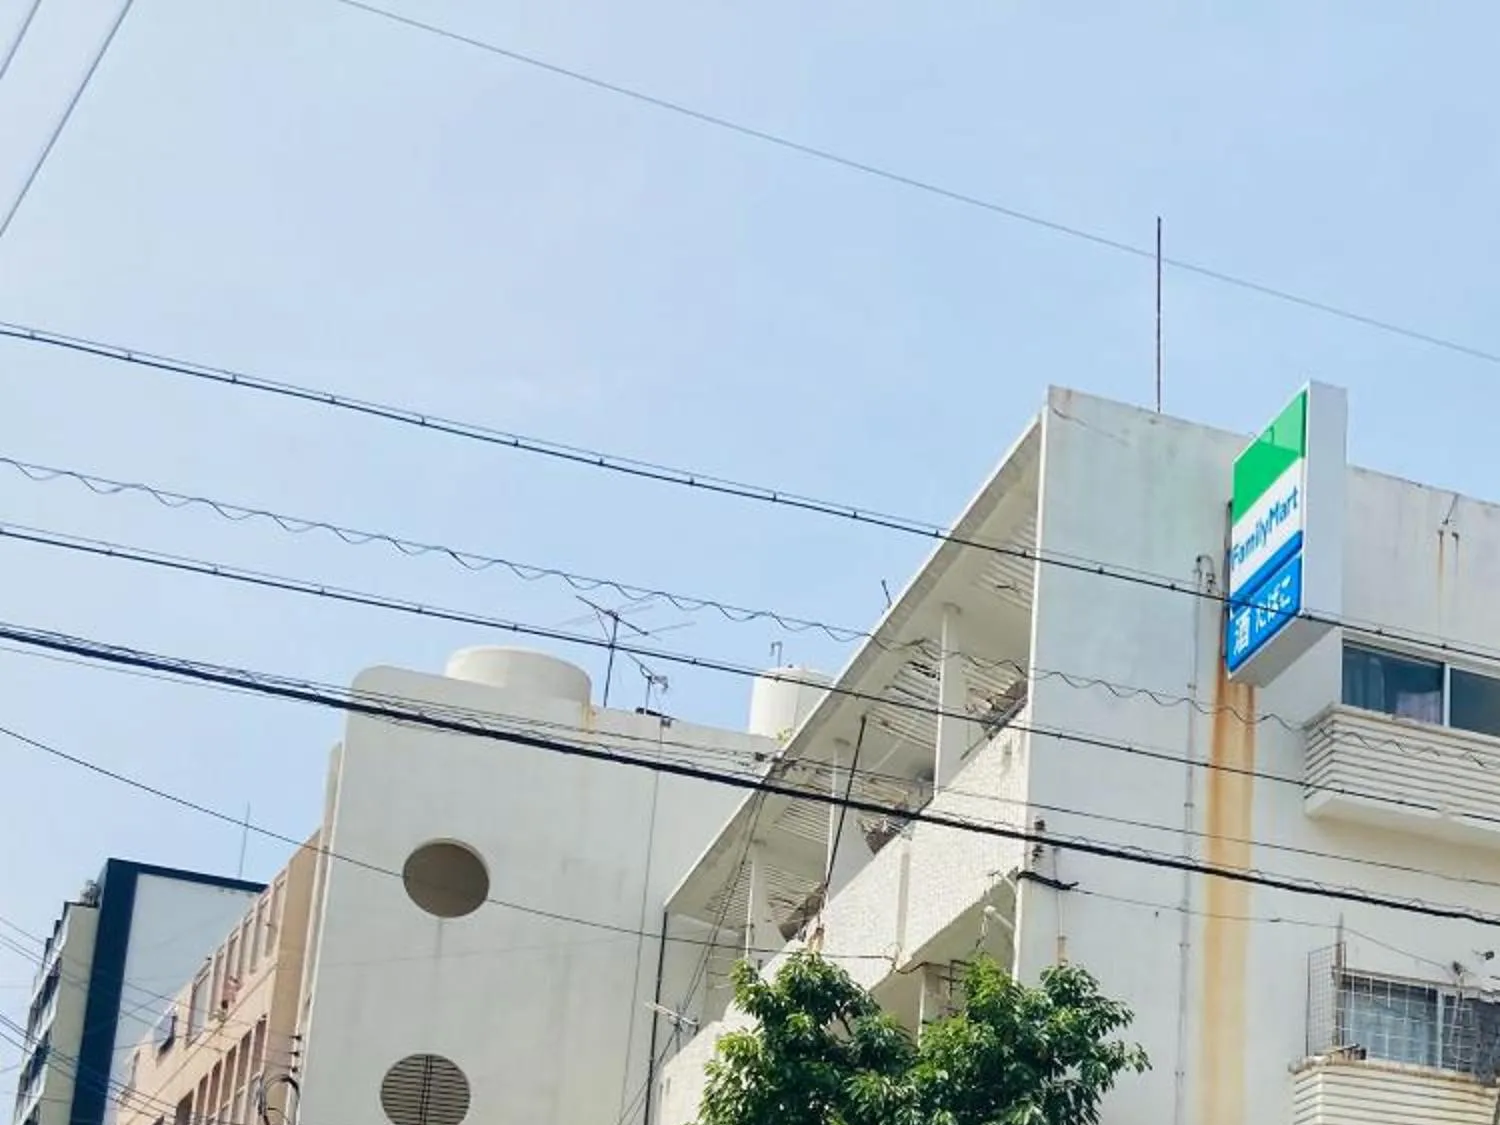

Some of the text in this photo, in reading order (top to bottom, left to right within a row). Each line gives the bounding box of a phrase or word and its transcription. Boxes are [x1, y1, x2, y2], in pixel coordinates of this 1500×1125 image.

[1231, 486, 1299, 571] FamilyMart
[1254, 574, 1292, 634] たばこ
